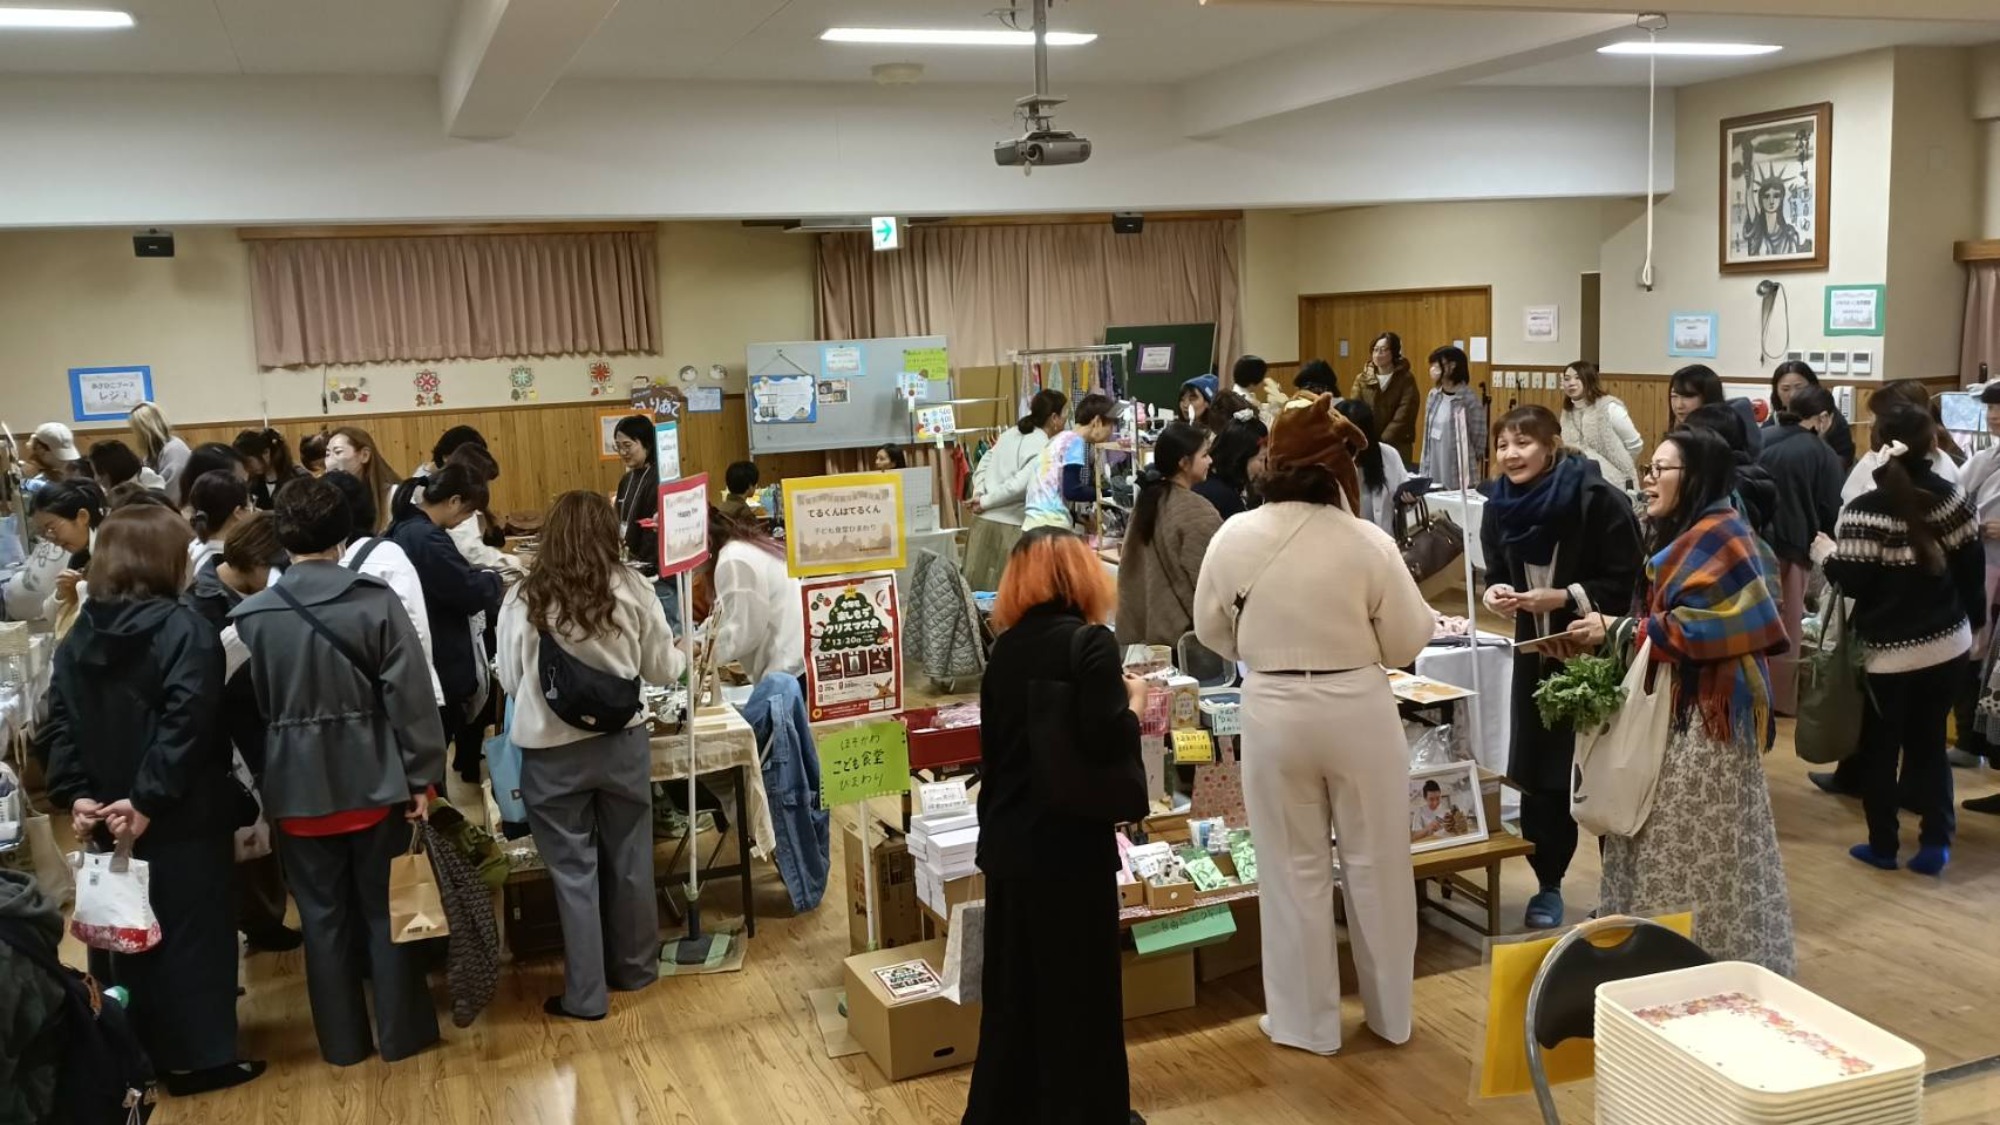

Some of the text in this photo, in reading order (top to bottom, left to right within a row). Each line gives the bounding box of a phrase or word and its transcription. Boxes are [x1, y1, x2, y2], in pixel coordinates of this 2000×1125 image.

[99, 391, 119, 401] レジ
[807, 505, 881, 518] てるくんはてるくん
[815, 524, 877, 535] 子ども食堂ひまわり
[820, 618, 880, 635] クリスマス会
[840, 734, 880, 751] ほそかわ
[832, 749, 885, 775] こども食堂
[840, 773, 884, 791] ひまわり
